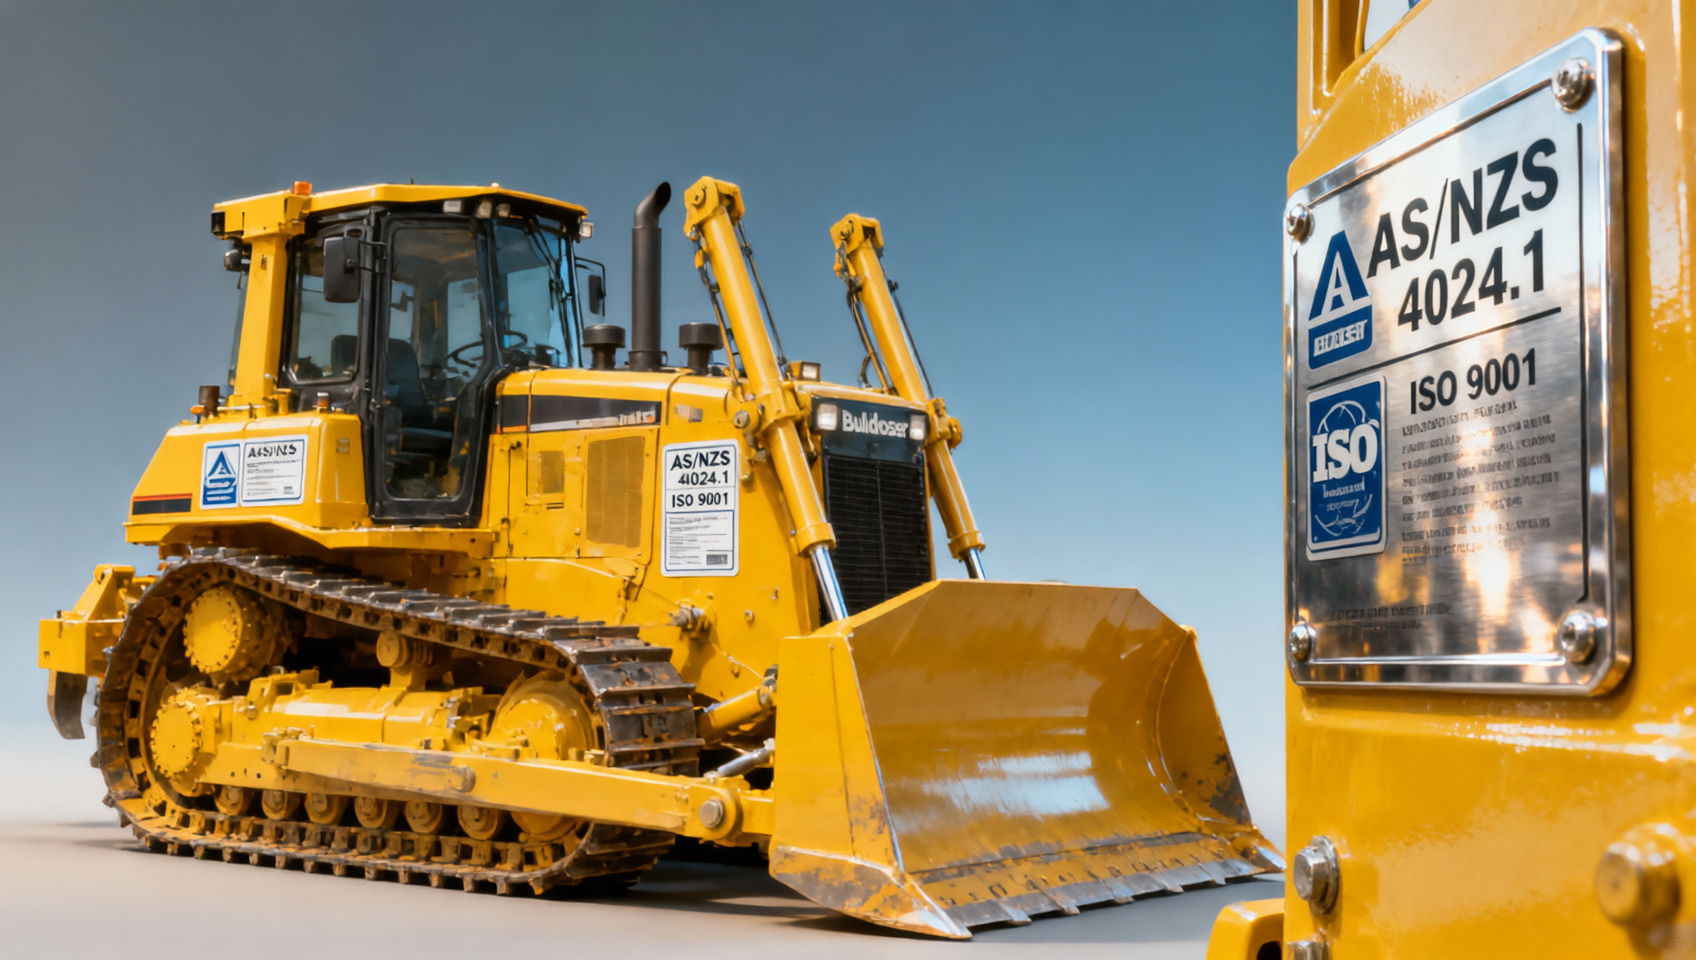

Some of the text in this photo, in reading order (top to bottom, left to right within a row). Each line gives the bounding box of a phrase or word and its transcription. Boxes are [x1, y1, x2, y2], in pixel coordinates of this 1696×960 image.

[1367, 138, 1559, 279] AS/NZS
[1397, 228, 1544, 332] 4024.1
[1410, 348, 1536, 414] ISO 9001
[670, 450, 731, 471] AS/NZS
[1312, 423, 1378, 483] ISO
[671, 492, 729, 508] ISO 9001
